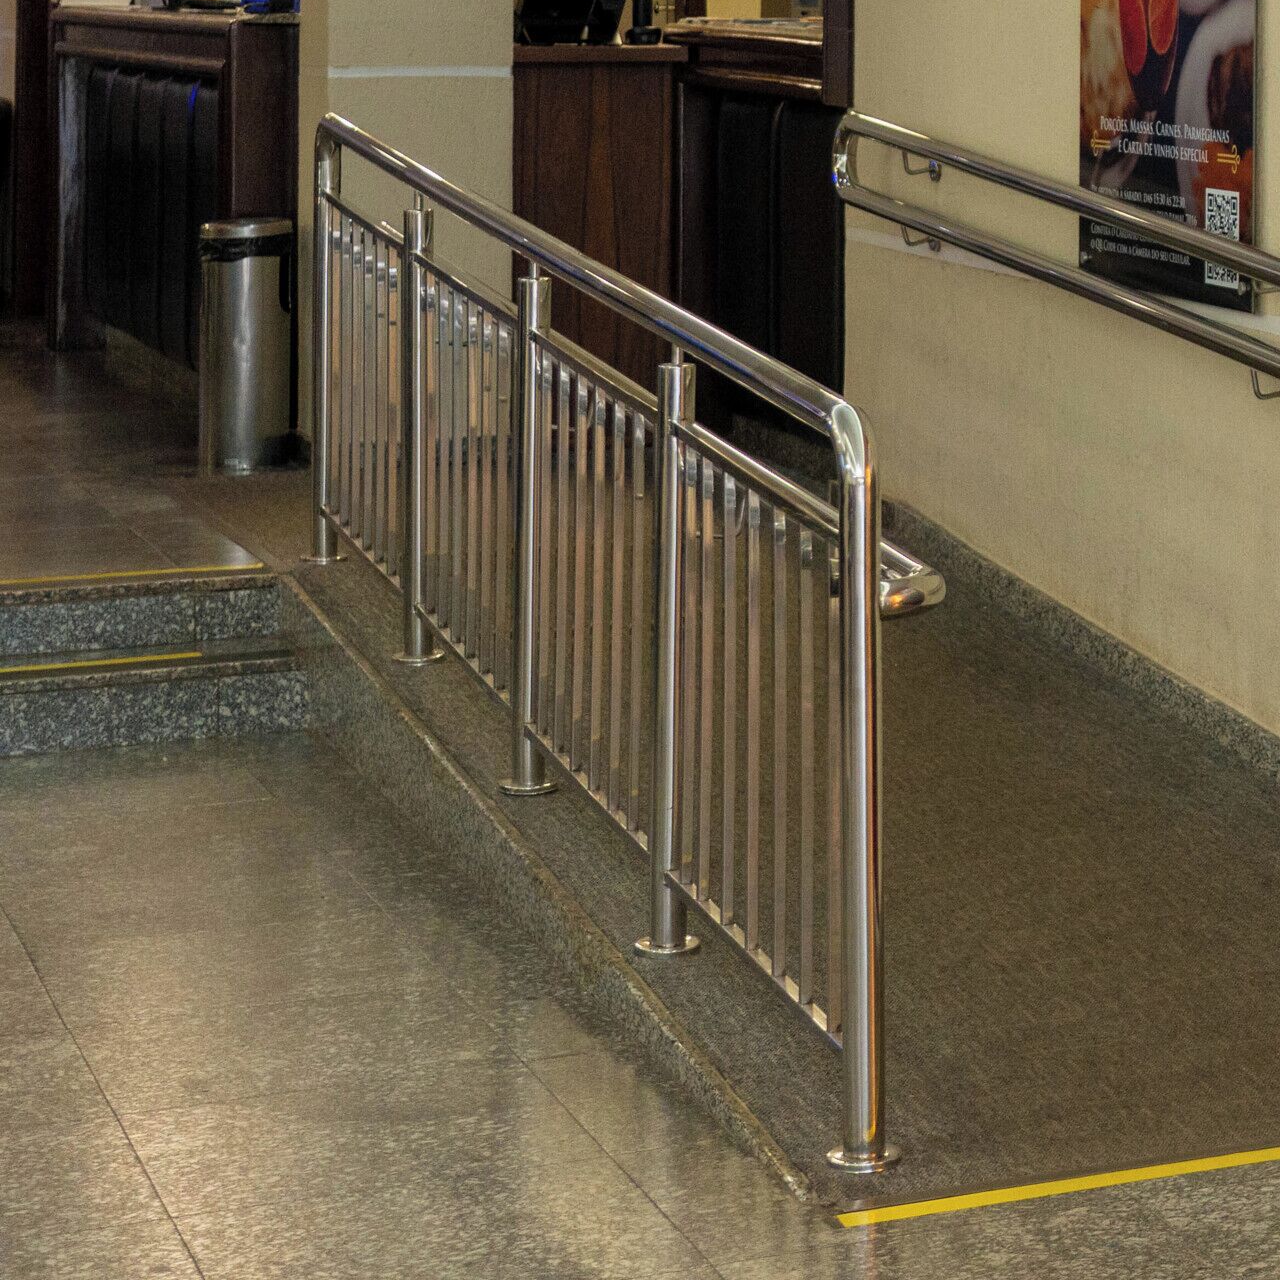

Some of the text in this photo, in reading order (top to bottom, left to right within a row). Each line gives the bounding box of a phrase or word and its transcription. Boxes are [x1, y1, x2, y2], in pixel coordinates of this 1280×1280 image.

[1183, 124, 1230, 144] PARMEGIANAS
[1122, 138, 1143, 155] CARTA
[1144, 143, 1153, 156] DE
[1153, 143, 1179, 160] VINHOS
[1180, 147, 1209, 163] ESPECIAL
